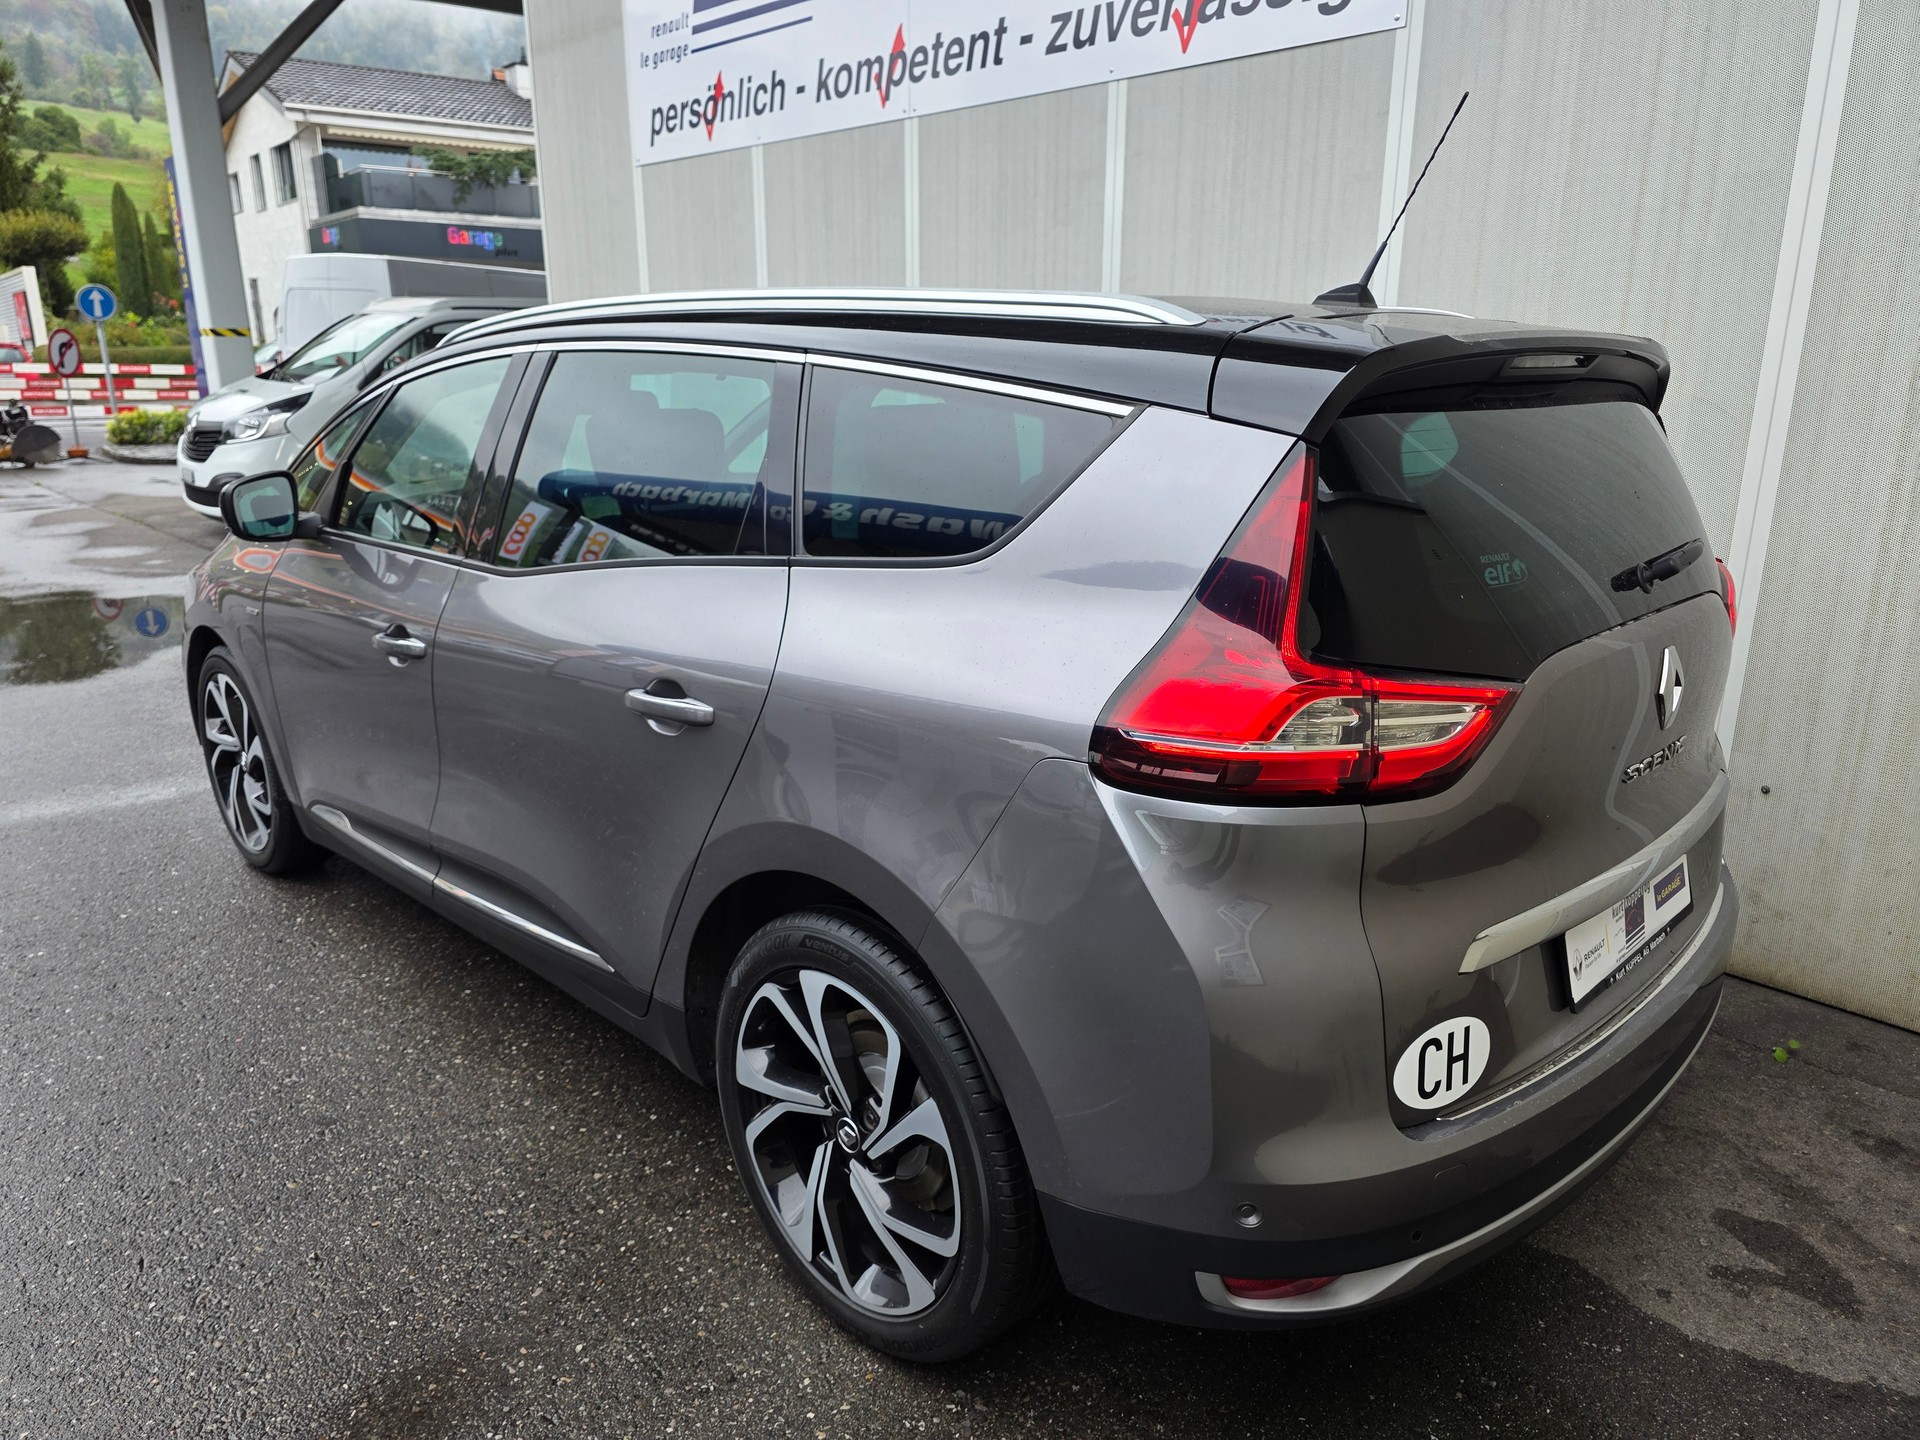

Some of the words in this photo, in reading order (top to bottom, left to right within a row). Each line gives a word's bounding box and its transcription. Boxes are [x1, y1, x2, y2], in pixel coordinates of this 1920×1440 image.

[651, 12, 690, 39] renault
[640, 52, 650, 69] le
[652, 43, 690, 69] garage
[650, 69, 786, 148] persönlich
[816, 16, 1009, 104] kompetent
[447, 226, 504, 252] Garage
[1480, 552, 1510, 564] RENAULT
[1484, 562, 1511, 585] elf
[1661, 877, 1682, 898] GARAGE
[1583, 938, 1606, 962] RENAULT
[1417, 1025, 1471, 1100] CH
